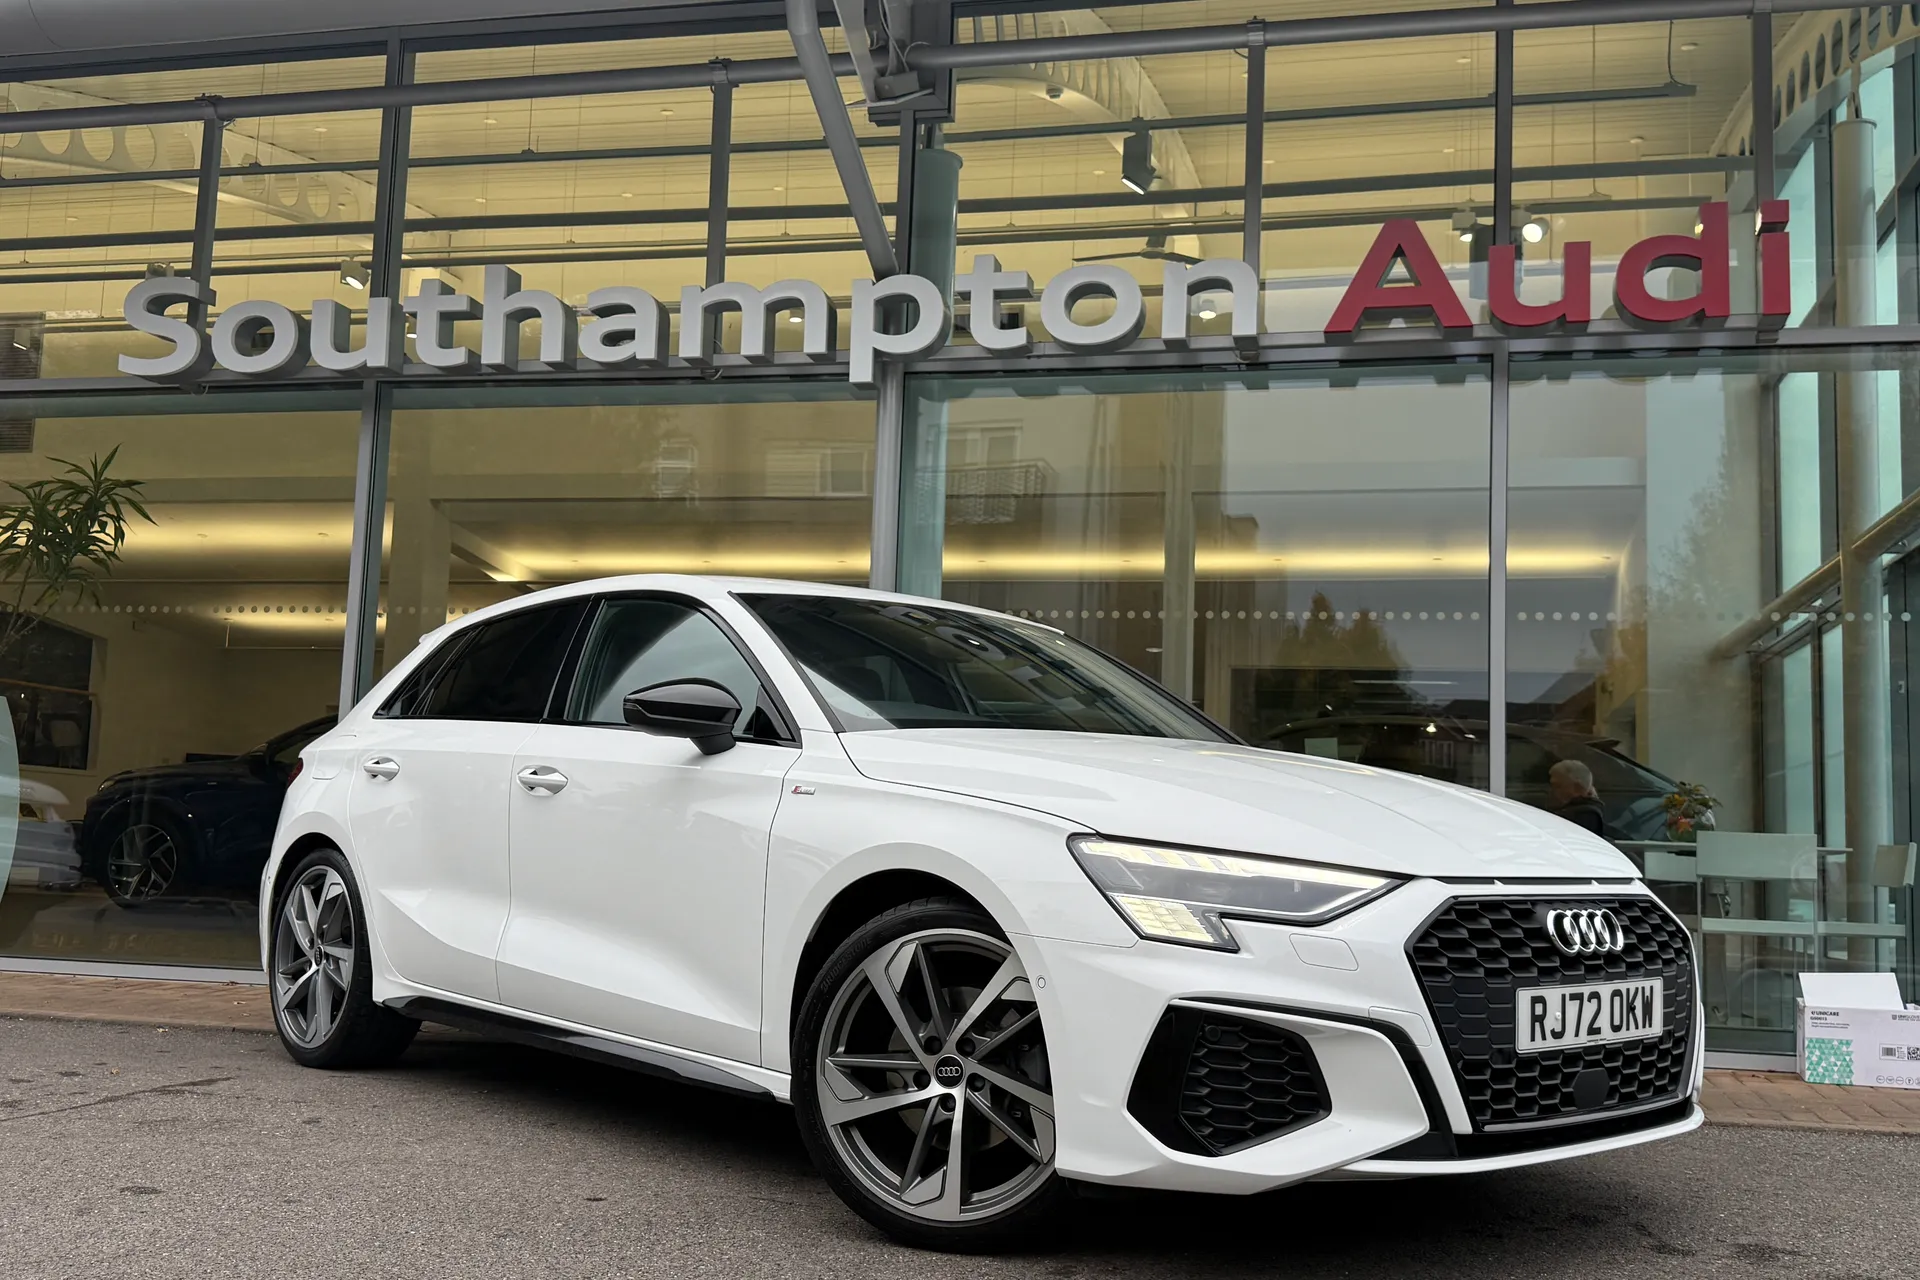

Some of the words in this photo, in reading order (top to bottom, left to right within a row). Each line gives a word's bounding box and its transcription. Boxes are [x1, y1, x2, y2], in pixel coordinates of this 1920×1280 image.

[118, 254, 1260, 383] Southampton
[1324, 200, 1790, 334] Audi
[1530, 991, 1602, 1042] RJ72
[1610, 985, 1654, 1033] OKW
